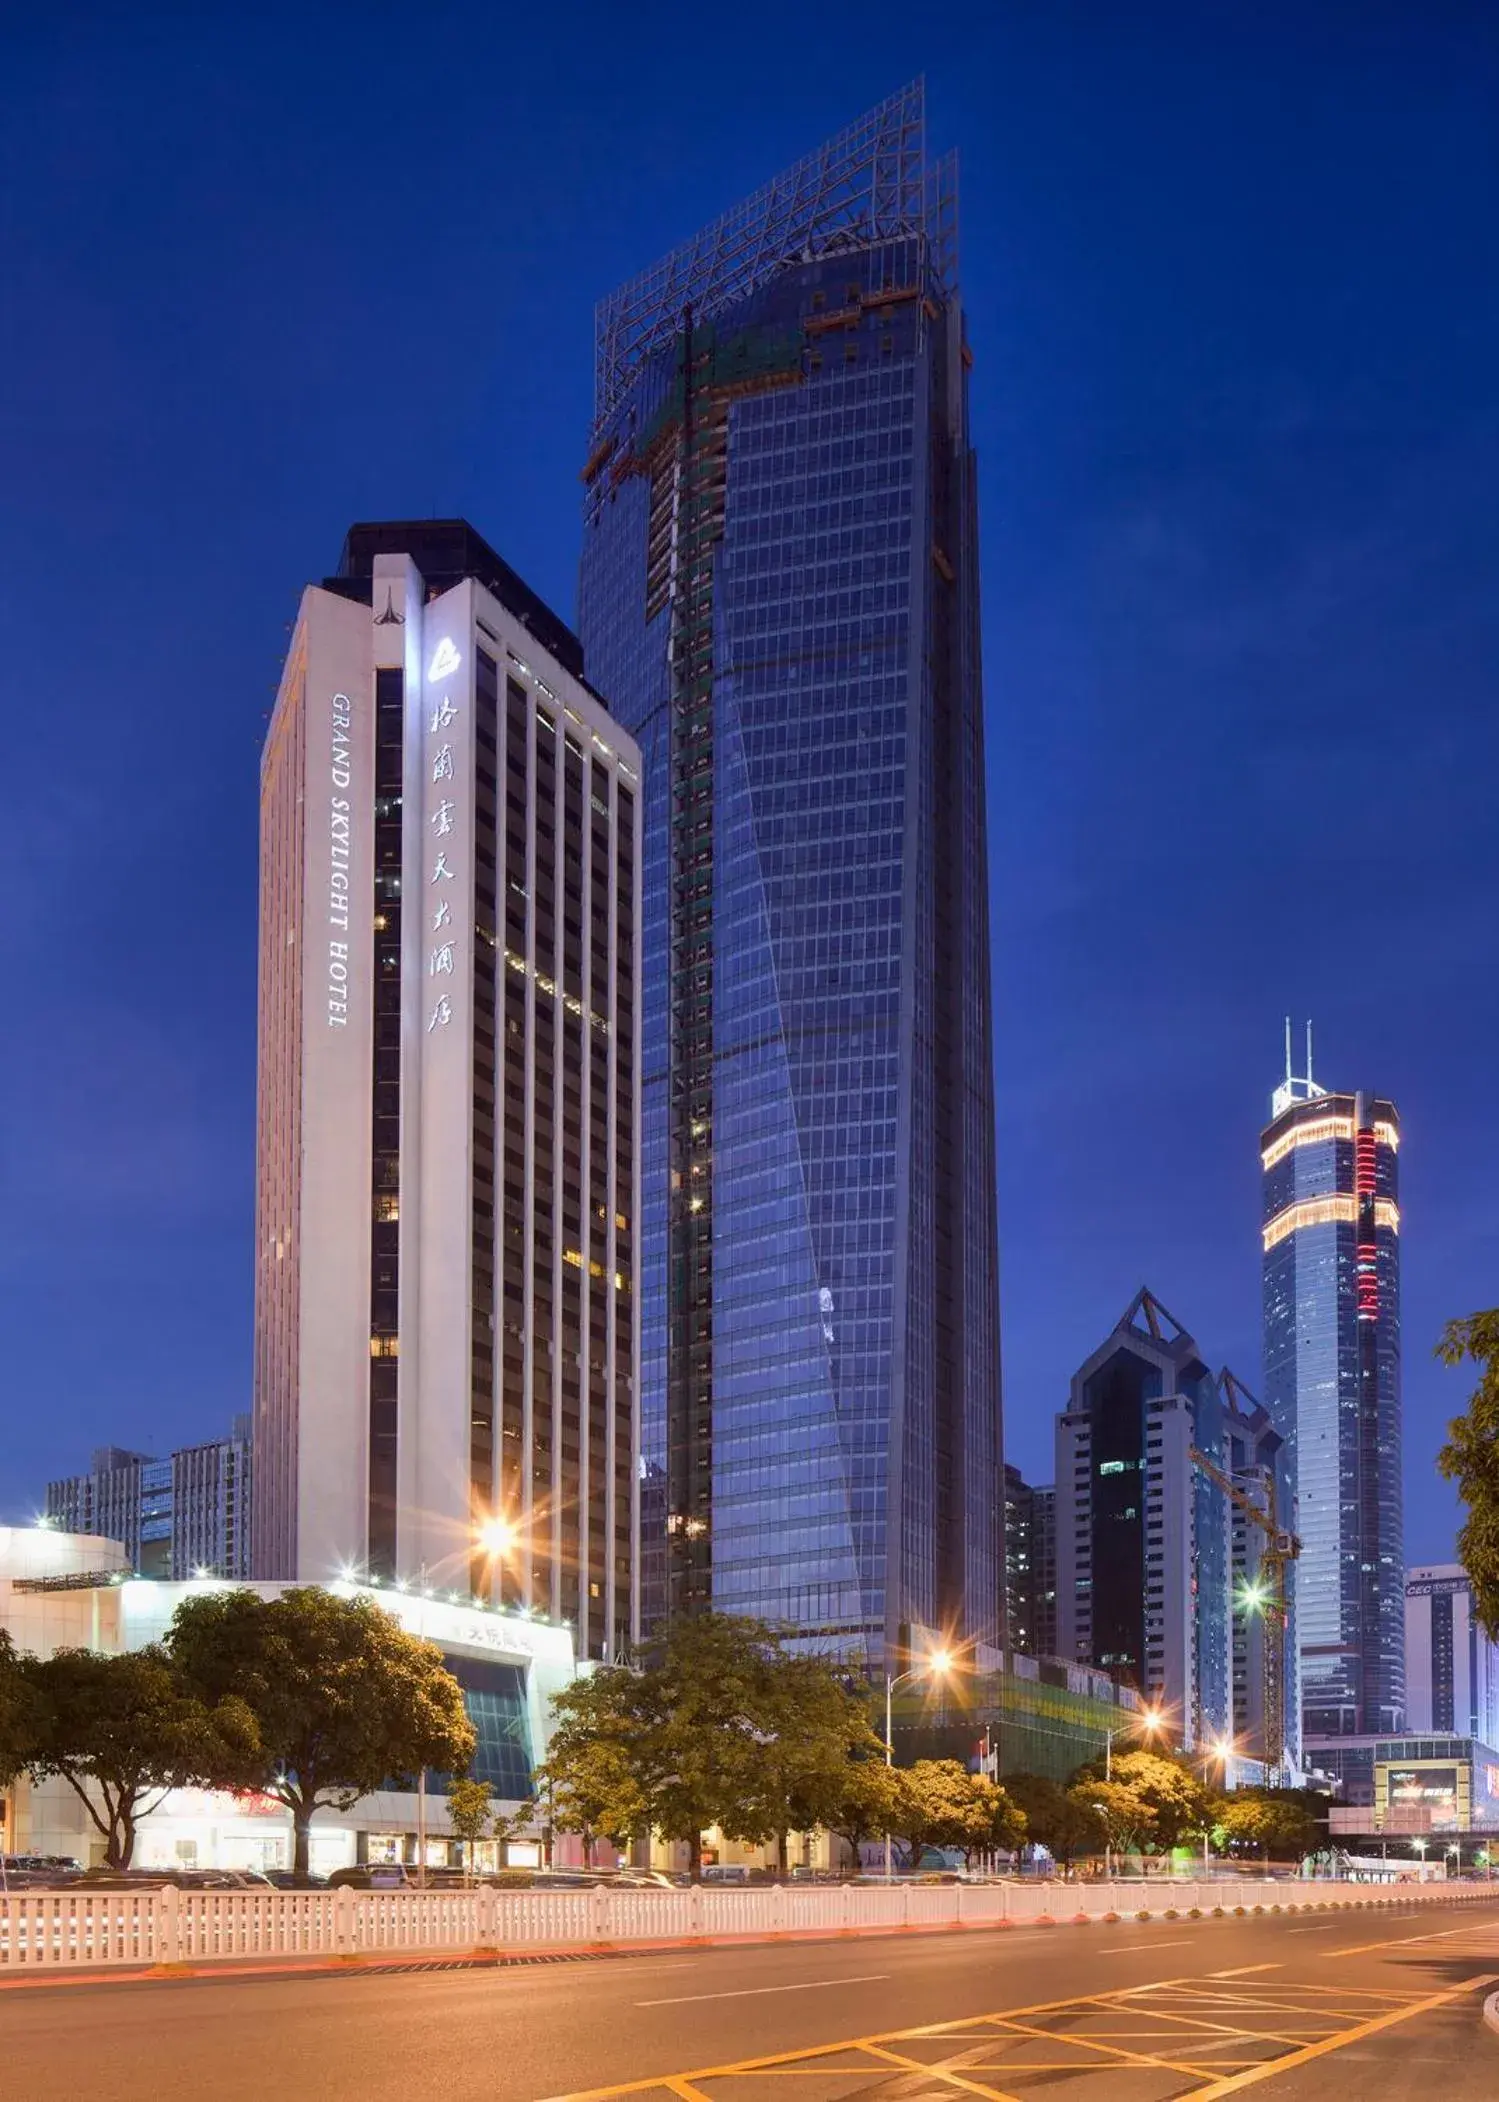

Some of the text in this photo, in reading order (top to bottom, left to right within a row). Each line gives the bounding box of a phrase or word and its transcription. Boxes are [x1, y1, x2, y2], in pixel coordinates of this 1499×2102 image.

[328, 693, 351, 1028] GRAND SKYLIGHT HOTEL
